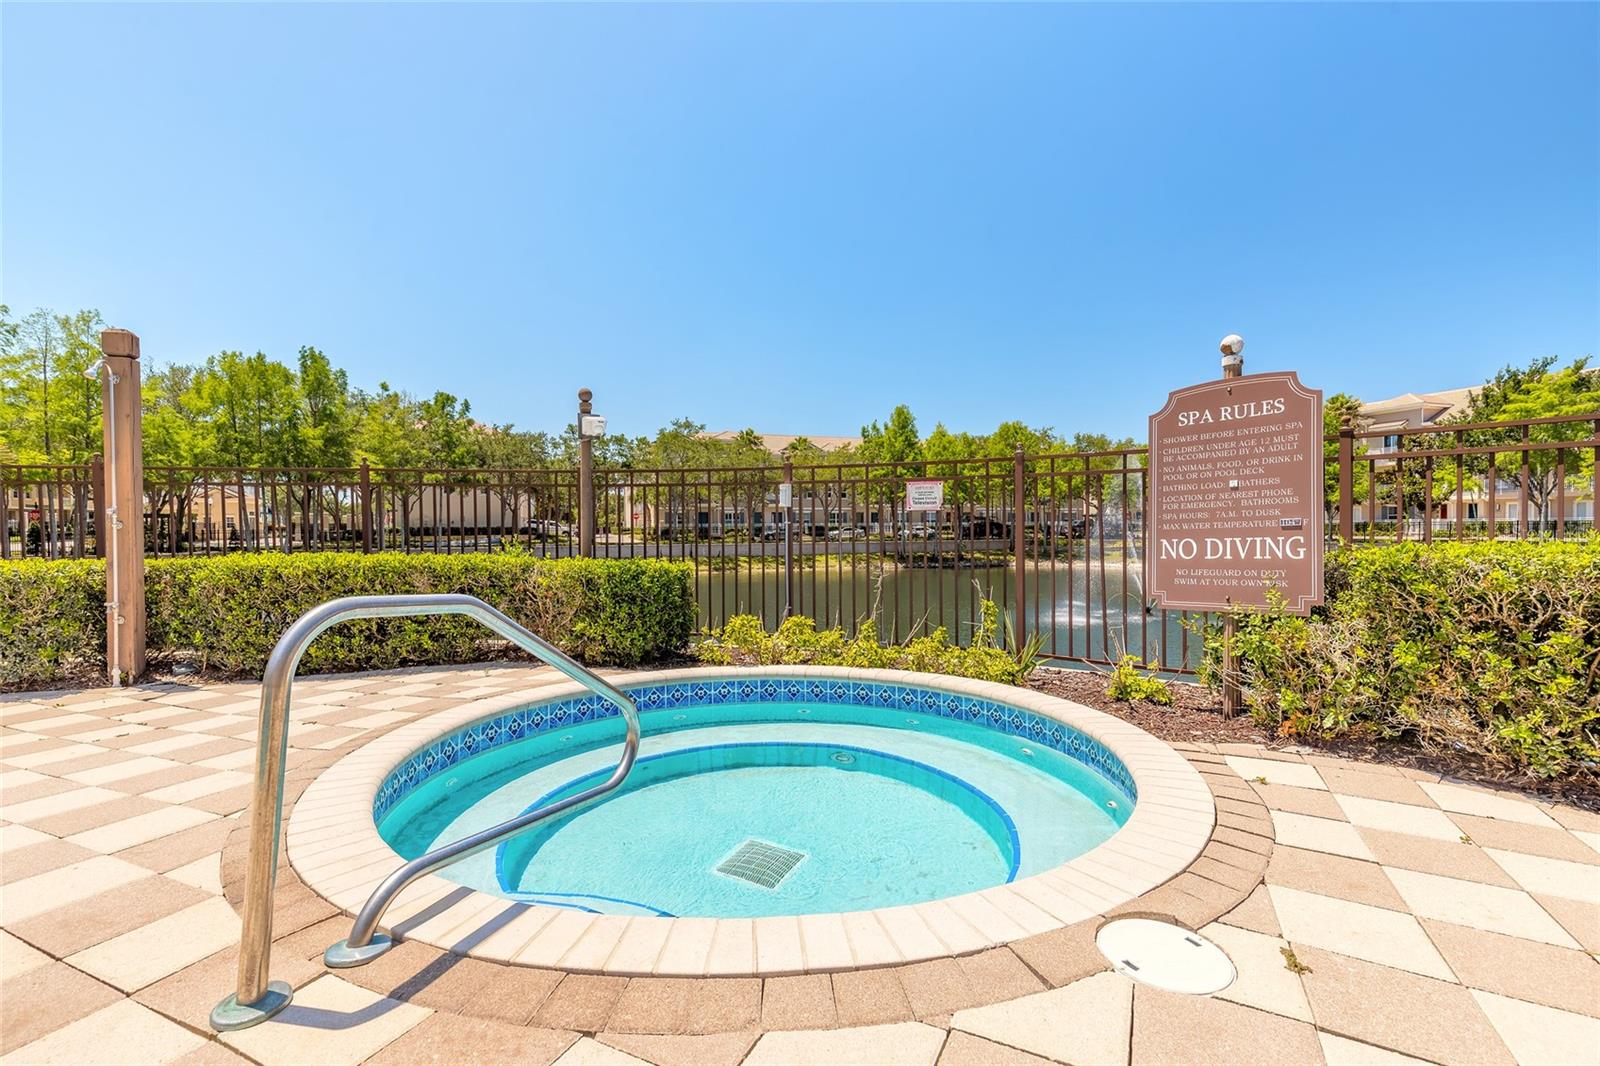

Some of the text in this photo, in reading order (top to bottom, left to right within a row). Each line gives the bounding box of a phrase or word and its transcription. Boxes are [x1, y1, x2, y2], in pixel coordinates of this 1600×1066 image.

[1178, 397, 1286, 427] SPA RULES
[1162, 421, 1304, 445] SHOWER BEFORE ENTERING SPA
[1162, 433, 1300, 456] CHILDREN UNDER AGE 12 MUST
[1163, 455, 1175, 463] BE
[1176, 450, 1238, 462] ACCOMPANIED
[1239, 447, 1251, 456] BY
[1268, 442, 1299, 453] ADULT
[1246, 458, 1260, 466] OR
[1262, 455, 1291, 465] DRINK
[1293, 453, 1304, 461] IN
[1200, 470, 1213, 479] ON
[1214, 469, 1238, 477] POOL
[1239, 466, 1266, 475] DECK
[1162, 482, 1199, 493] BATHING
[1200, 481, 1226, 490] LOAD:
[1238, 477, 1281, 488] BATHERS
[1162, 487, 1294, 503] LOCATION OF NEAREST PHONE
[1162, 502, 1180, 511] FOR
[1240, 496, 1300, 506] BATHROOMS
[1241, 509, 1254, 517] TO
[1255, 508, 1281, 516] DUSK
[1162, 522, 1181, 530] MAX
[1181, 521, 1211, 530] WATER
[1213, 519, 1280, 529] TEMPERATURE
[1160, 536, 1307, 560] NO DIVING
[1175, 568, 1189, 576] NO
[1190, 568, 1242, 577] LIFEGUARD
[1243, 569, 1258, 577] ON
[1212, 579, 1239, 587] YOUR
[1240, 579, 1263, 587] OWN
